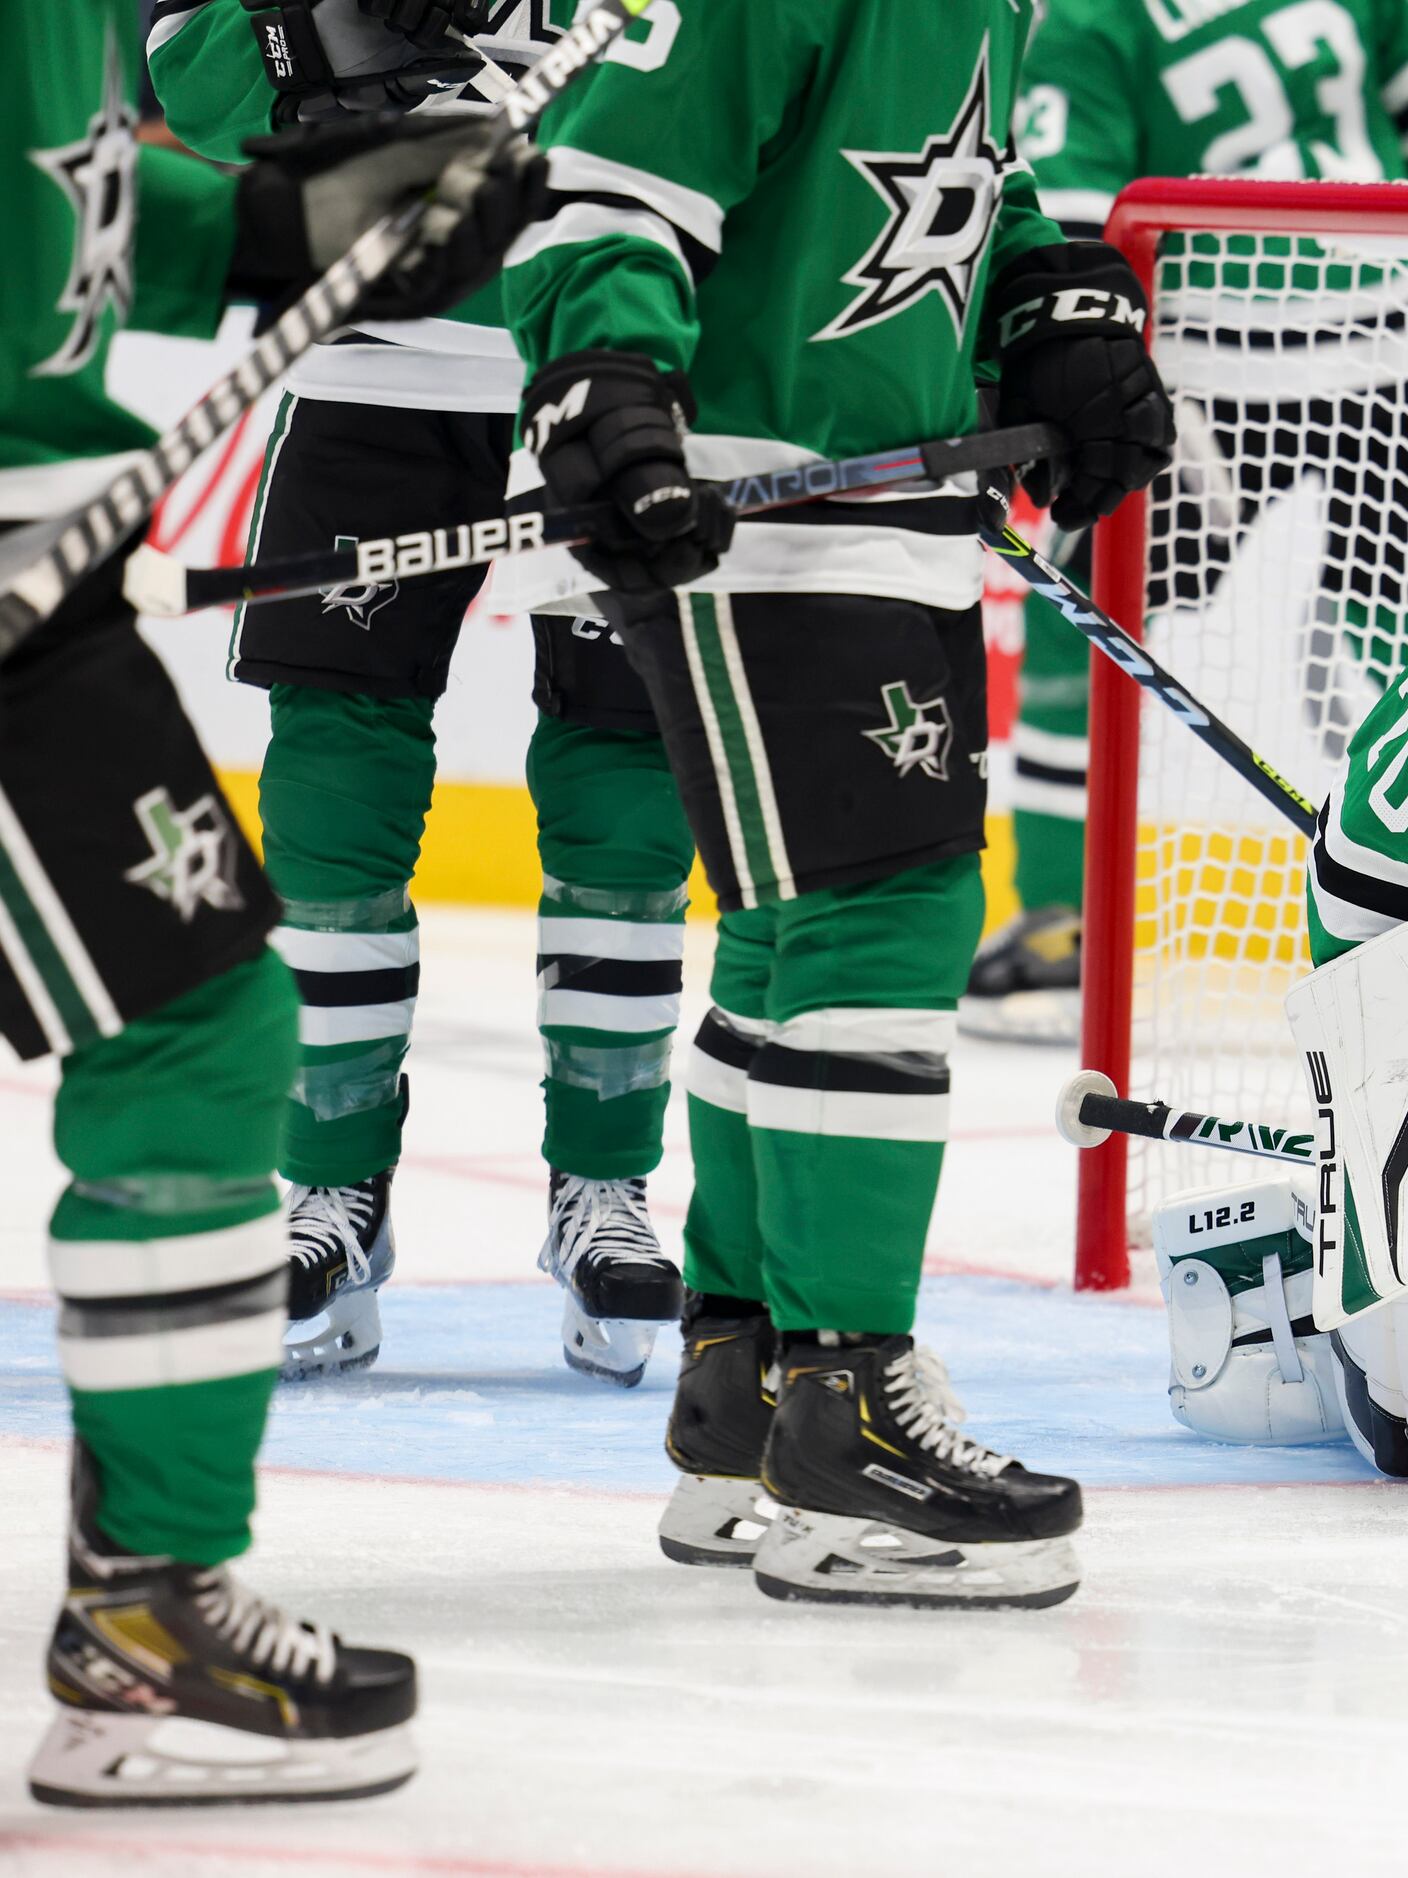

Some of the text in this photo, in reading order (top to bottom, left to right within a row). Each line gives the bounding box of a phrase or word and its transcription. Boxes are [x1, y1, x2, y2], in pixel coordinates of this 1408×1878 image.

[1160, 0, 1384, 183] 23
[998, 288, 1146, 348] CCM
[357, 511, 545, 584] BAUER
[1306, 1051, 1336, 1277] TRUE
[1189, 1201, 1255, 1233] L12.2
